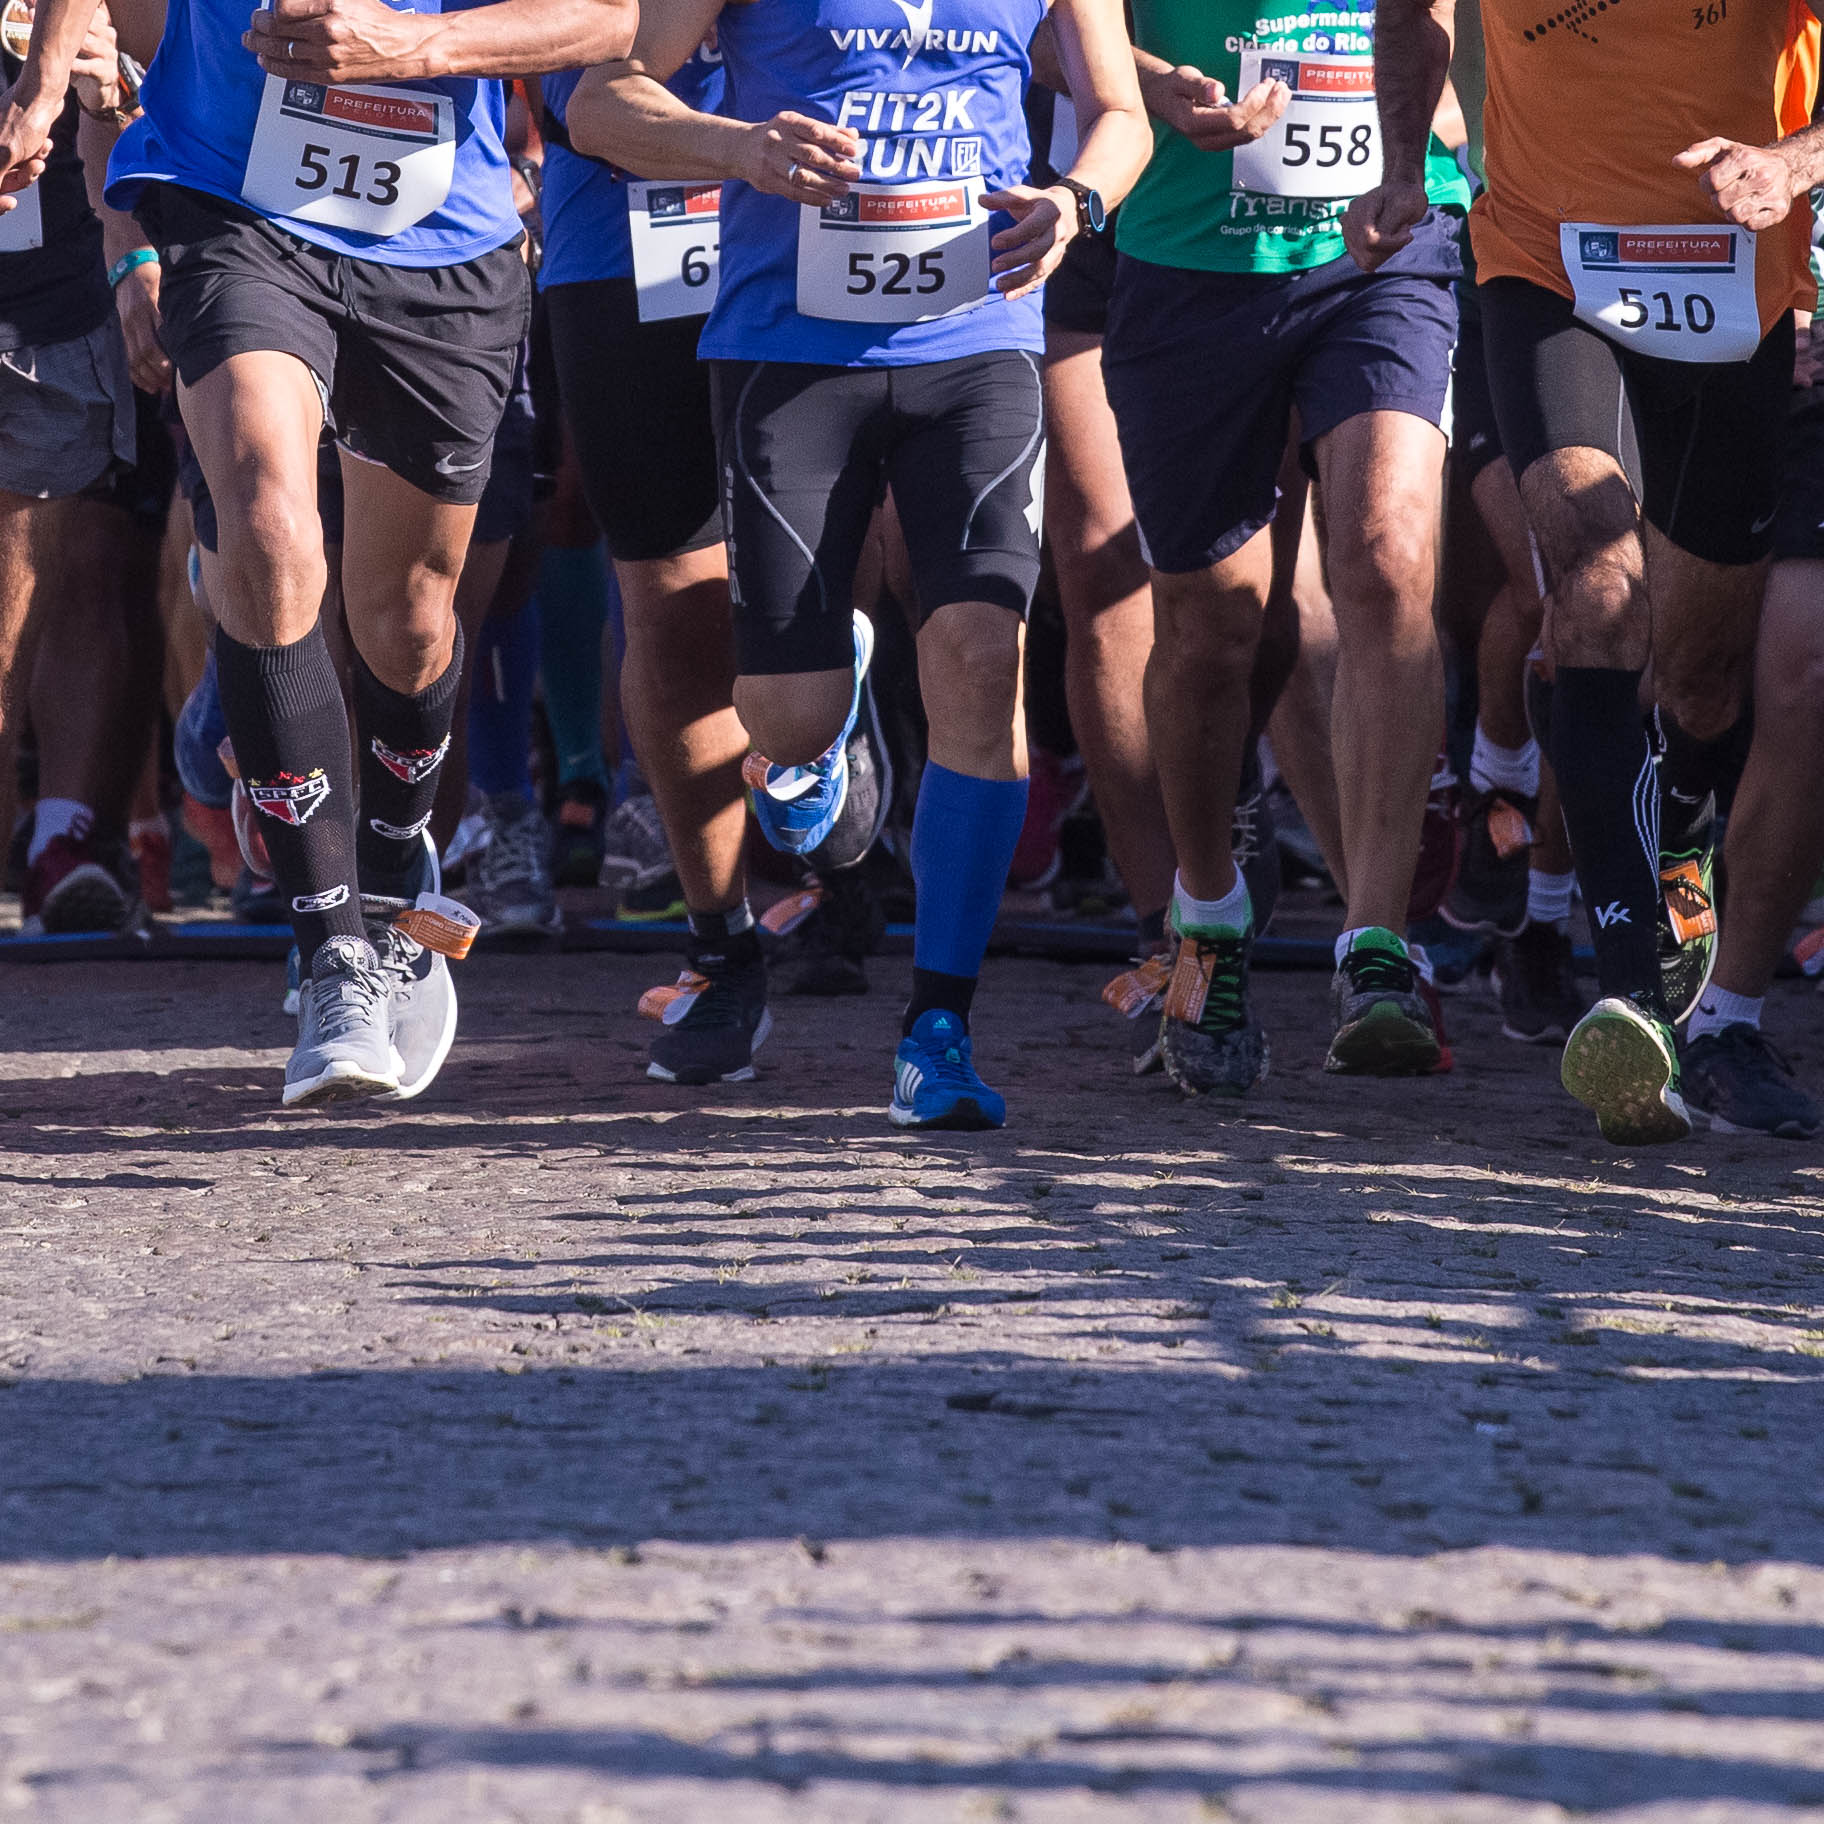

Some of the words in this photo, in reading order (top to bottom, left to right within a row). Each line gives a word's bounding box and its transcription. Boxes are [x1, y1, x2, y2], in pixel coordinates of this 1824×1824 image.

[925, 28, 999, 54] RUN
[1302, 34, 1330, 52] do
[1333, 32, 1370, 52] Rio
[332, 94, 427, 118] PREFEITURA
[836, 88, 978, 132] FIT2K
[1281, 122, 1373, 168] 558
[295, 143, 402, 207] 513
[867, 194, 959, 209] PREFEITURA
[681, 244, 721, 289] 6
[1625, 239, 1722, 250] PREFEITURA
[846, 250, 947, 297] 525
[1617, 286, 1717, 335] 510
